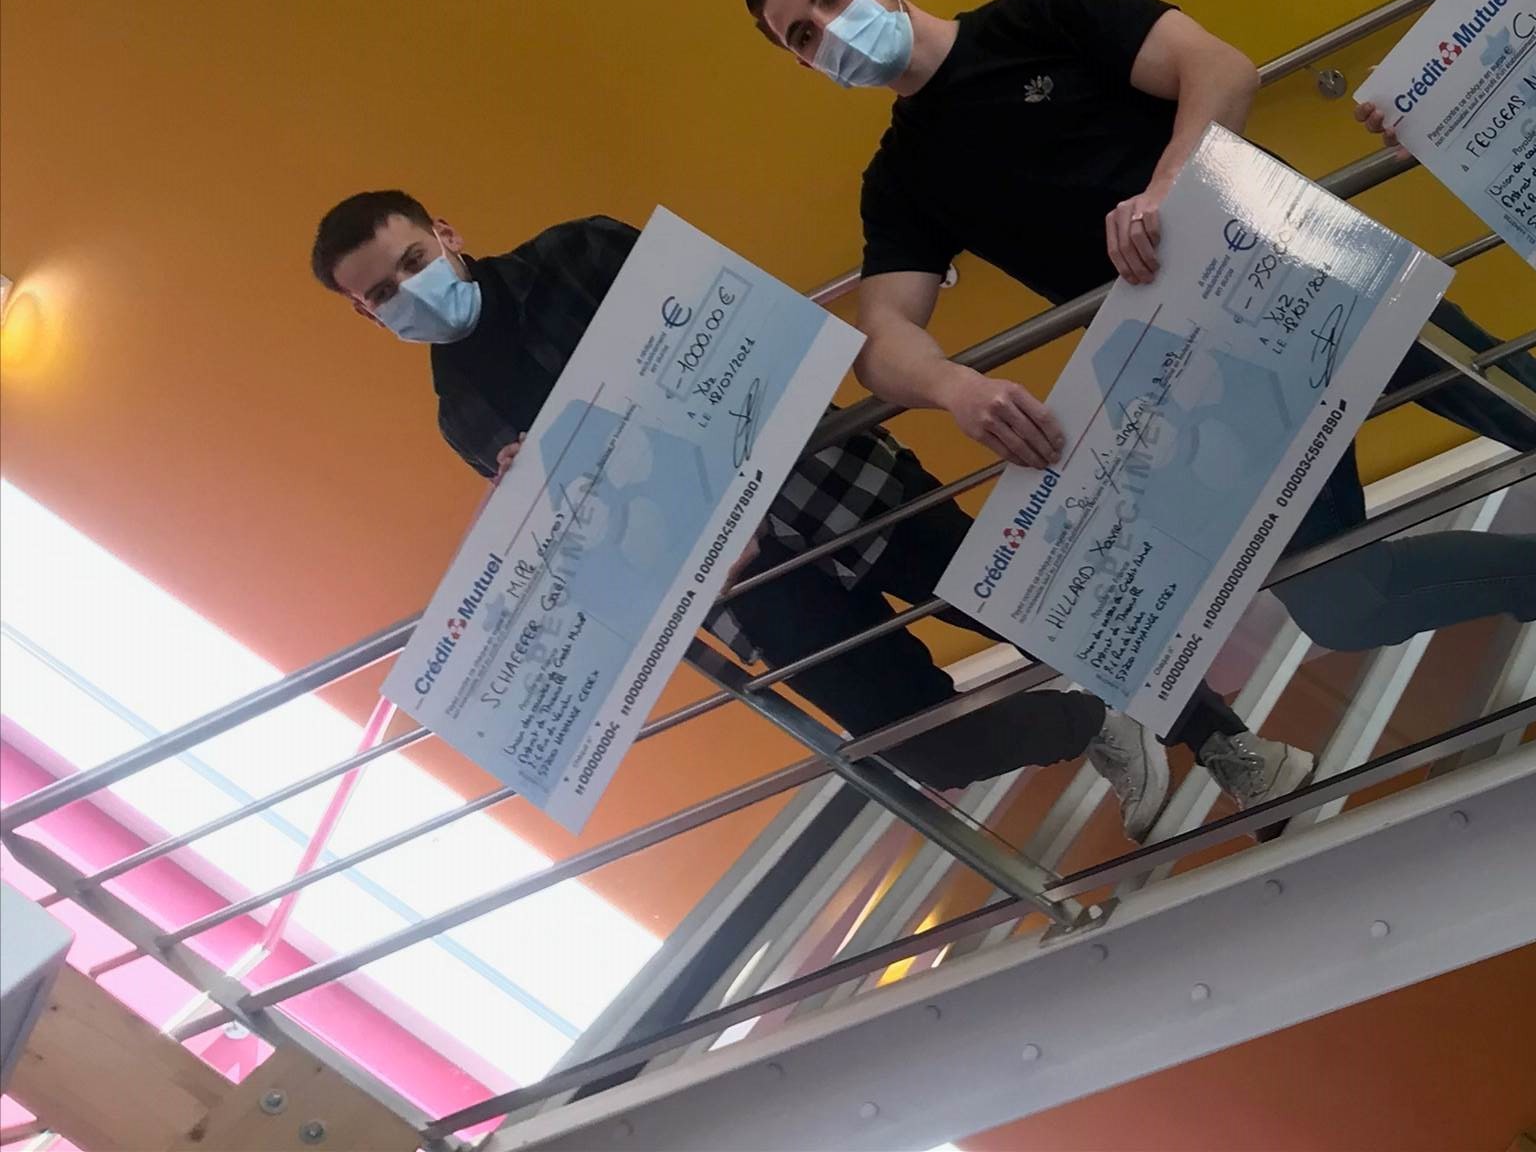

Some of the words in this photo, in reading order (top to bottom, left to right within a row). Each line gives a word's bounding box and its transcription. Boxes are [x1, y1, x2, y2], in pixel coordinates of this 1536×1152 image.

[1390, 55, 1448, 116] Crédit
[1463, 91, 1528, 159] FEUGEAS
[970, 541, 1016, 601] Crédit
[1012, 465, 1061, 531] Mutuel
[411, 632, 457, 698] Crédit
[456, 551, 504, 621] Mutuel
